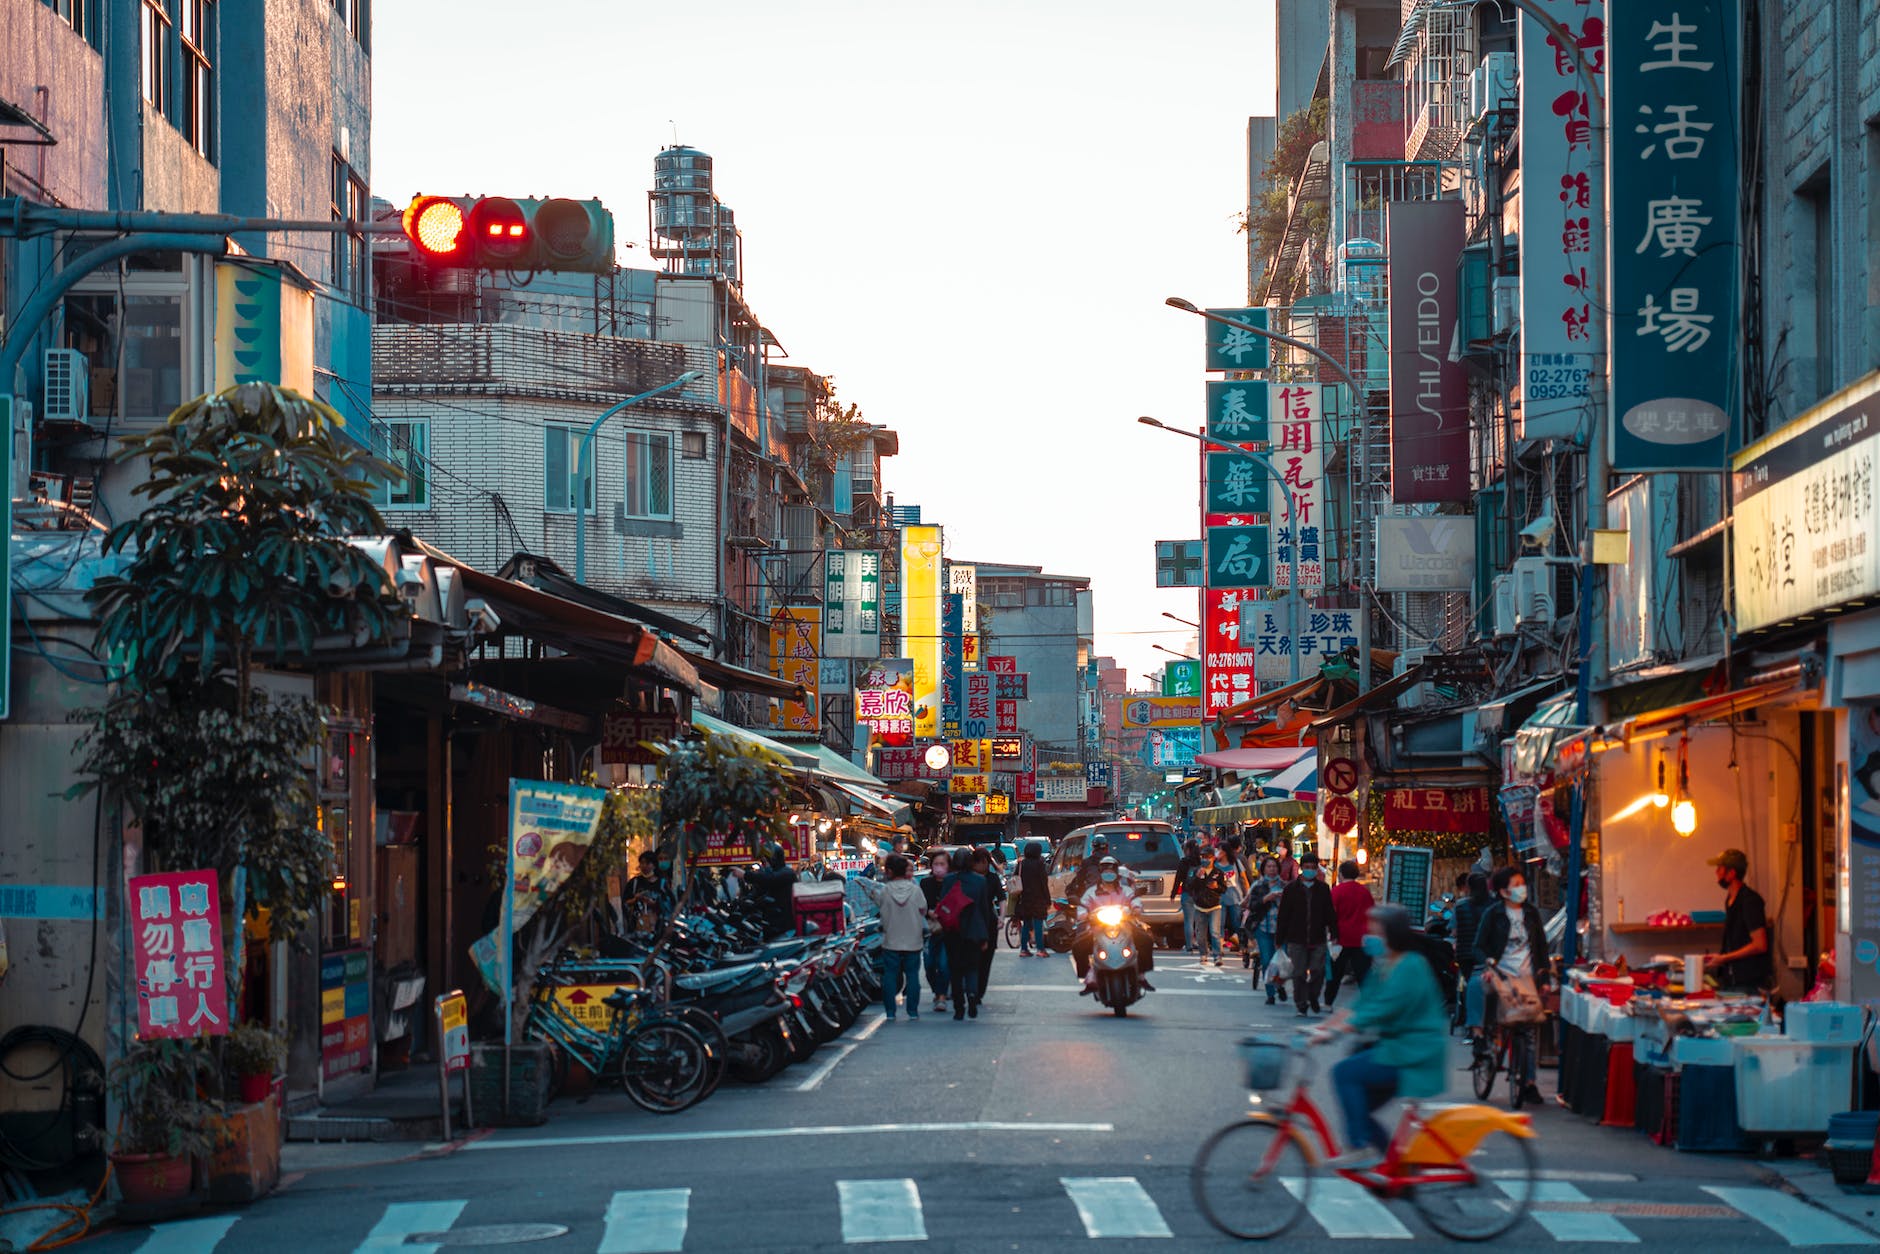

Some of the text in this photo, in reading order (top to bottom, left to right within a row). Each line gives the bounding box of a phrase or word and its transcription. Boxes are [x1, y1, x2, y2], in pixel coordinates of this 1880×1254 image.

[1634, 12, 1714, 352] 生活廣場
[1415, 271, 1442, 431] SHISEIDO
[1278, 387, 1315, 524] 信用瓦斯
[1411, 464, 1450, 483] 資生堂
[828, 554, 844, 631] 東明牌
[861, 554, 878, 632] 美利達
[859, 689, 911, 717] 嘉欣
[967, 674, 990, 719] 剪髮
[965, 721, 986, 738] 100
[1330, 803, 1351, 827] 停
